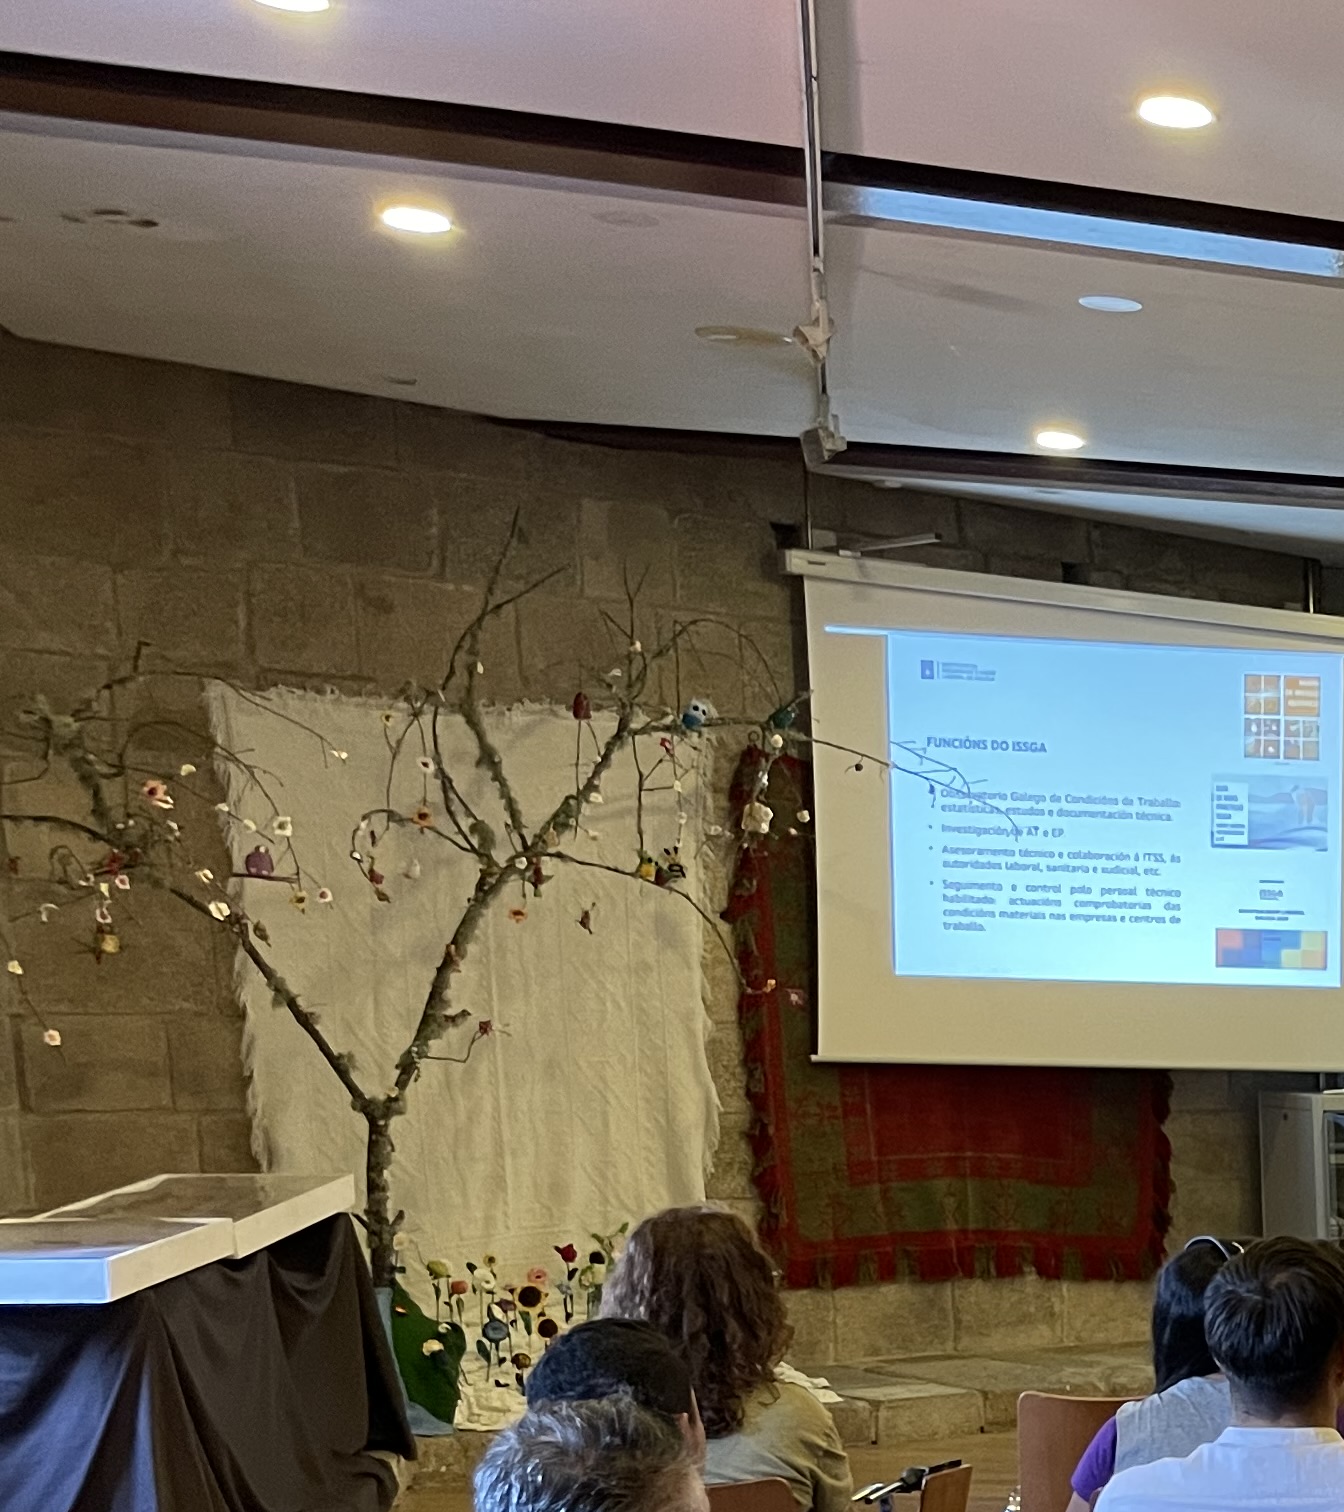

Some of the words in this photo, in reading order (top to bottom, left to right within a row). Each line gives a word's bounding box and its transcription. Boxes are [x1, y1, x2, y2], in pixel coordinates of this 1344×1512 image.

[926, 735, 988, 750] FUNCIÓNS
[991, 740, 1009, 751] DO
[1012, 741, 1047, 753] ISSGA
[1047, 809, 1054, 817] e
[1026, 825, 1040, 837] AT
[1043, 829, 1049, 838] e
[1057, 851, 1064, 859] e
[1092, 866, 1098, 874] e
[1011, 883, 1017, 892] e
[1025, 883, 1061, 894] control
[1120, 915, 1126, 923] e
[1169, 915, 1181, 924] de
